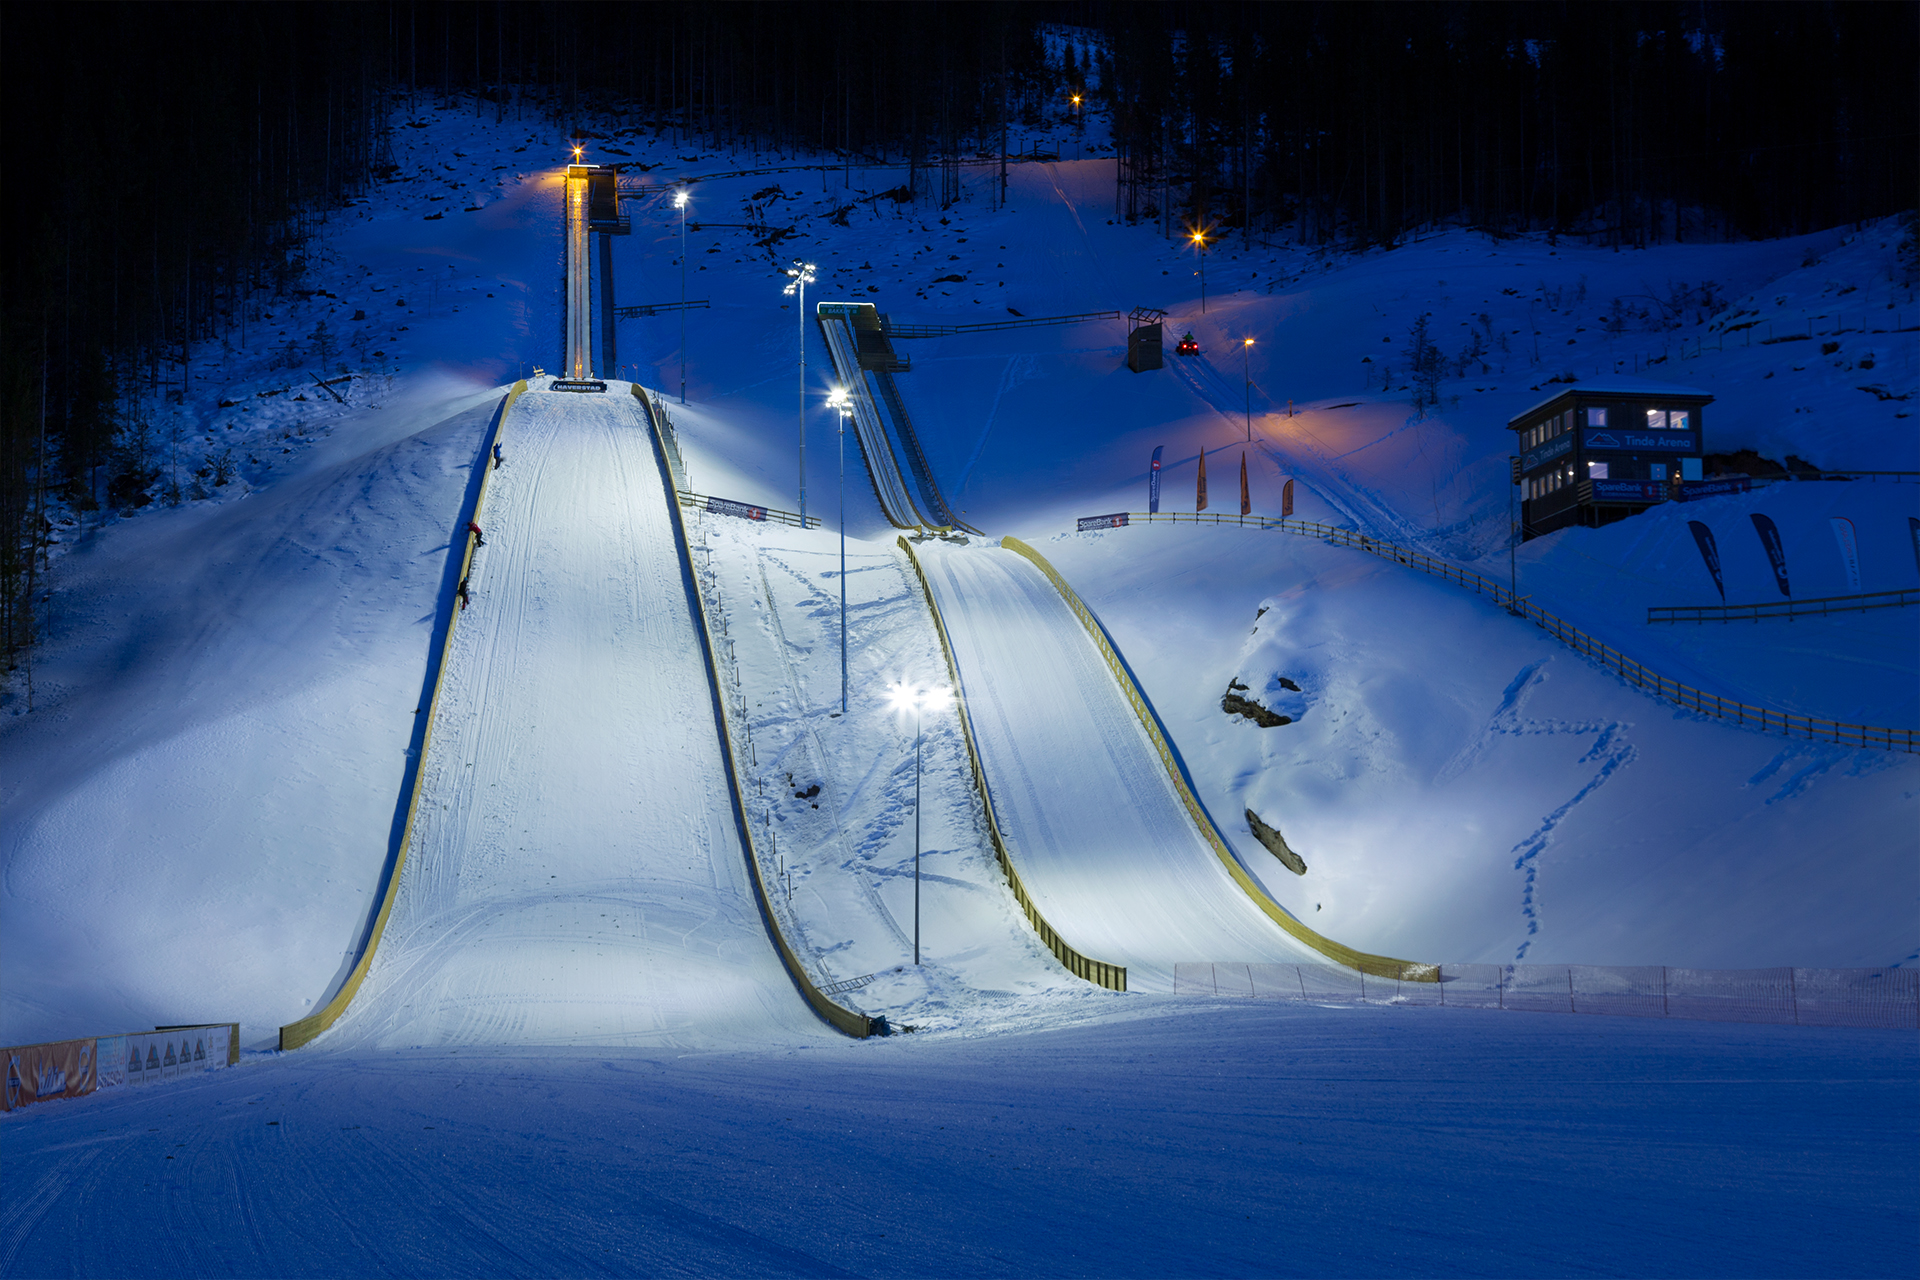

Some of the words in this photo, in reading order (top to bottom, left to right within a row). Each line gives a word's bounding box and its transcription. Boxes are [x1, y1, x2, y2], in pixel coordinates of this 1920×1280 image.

[1625, 435, 1655, 445] Tinde
[1657, 436, 1691, 448] Arena
[1540, 446, 1553, 459] Tinde
[1554, 441, 1571, 454] Arena
[1596, 481, 1642, 493] SpareBank
[1682, 483, 1732, 496] SpareBank
[709, 500, 749, 513] SpareBank
[1079, 517, 1113, 528] SpareBank
